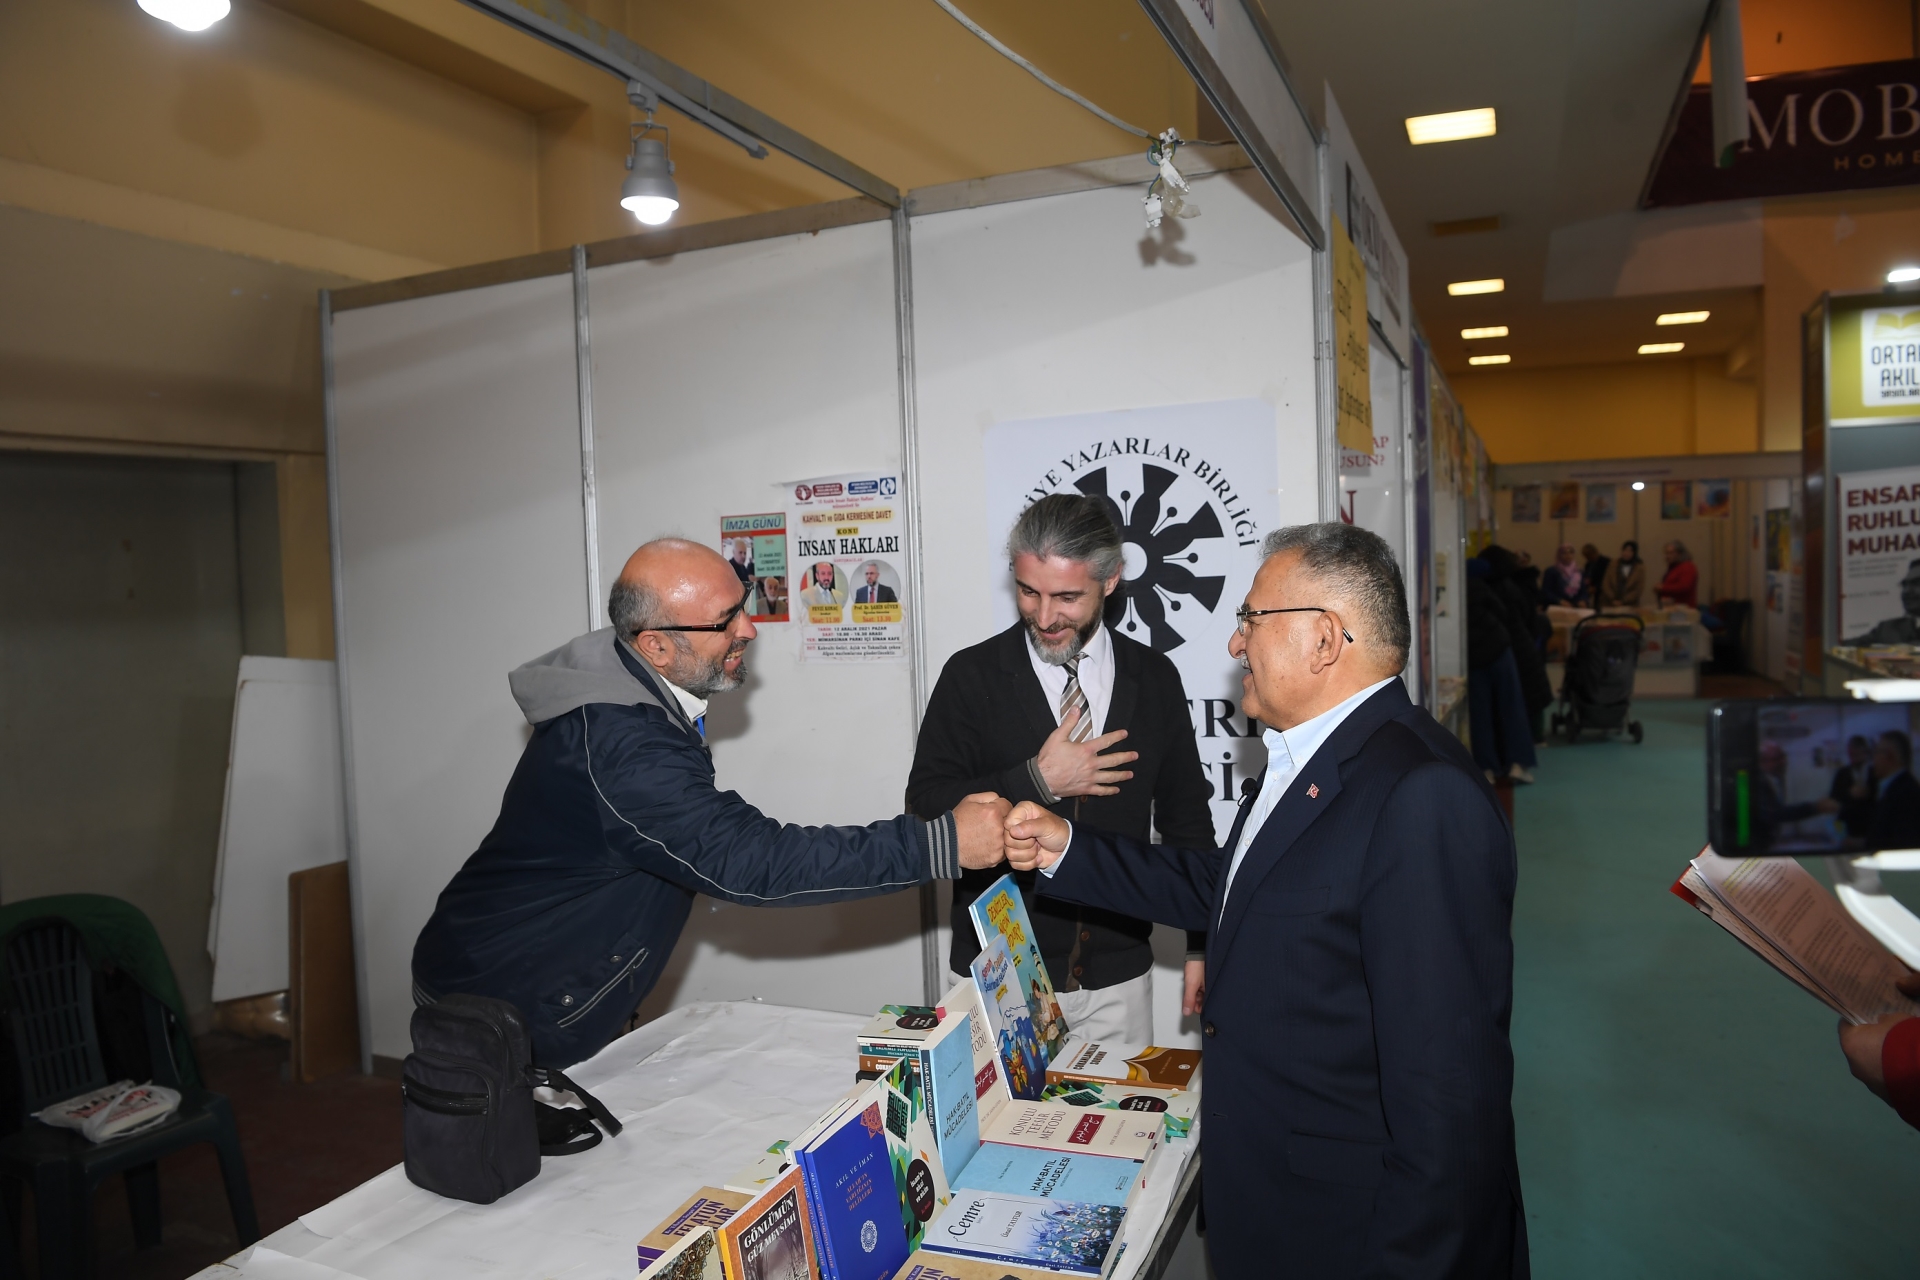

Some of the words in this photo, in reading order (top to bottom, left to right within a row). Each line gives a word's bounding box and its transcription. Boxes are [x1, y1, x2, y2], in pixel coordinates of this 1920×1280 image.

[1871, 344, 1920, 365] ORTA
[1061, 437, 1190, 473] YAZARLAR
[1192, 459, 1261, 548] BİRLİĞİ
[725, 518, 750, 530] İMZA
[752, 516, 782, 529] GÜNÜ
[876, 510, 892, 519] DAVET
[798, 536, 836, 557] İNSAN
[840, 536, 899, 555] HAKLARI
[1848, 533, 1920, 557] MUHA
[1009, 1107, 1037, 1136] KONULU
[1026, 1112, 1050, 1134] TEFSİR
[1038, 1110, 1066, 1141] METODU
[835, 1174, 849, 1189] AKIL
[849, 1166, 858, 1175] VE
[859, 1152, 874, 1168] İMAN
[1030, 1159, 1057, 1192] HAK-BATIL
[1040, 1157, 1072, 1197] MÜCADELESİ
[744, 1195, 794, 1249] GÖNLÜMÜN
[947, 1200, 985, 1237] Cemre
[747, 1243, 765, 1263] GÜZ
[764, 1211, 796, 1246] MEVSİMİ
